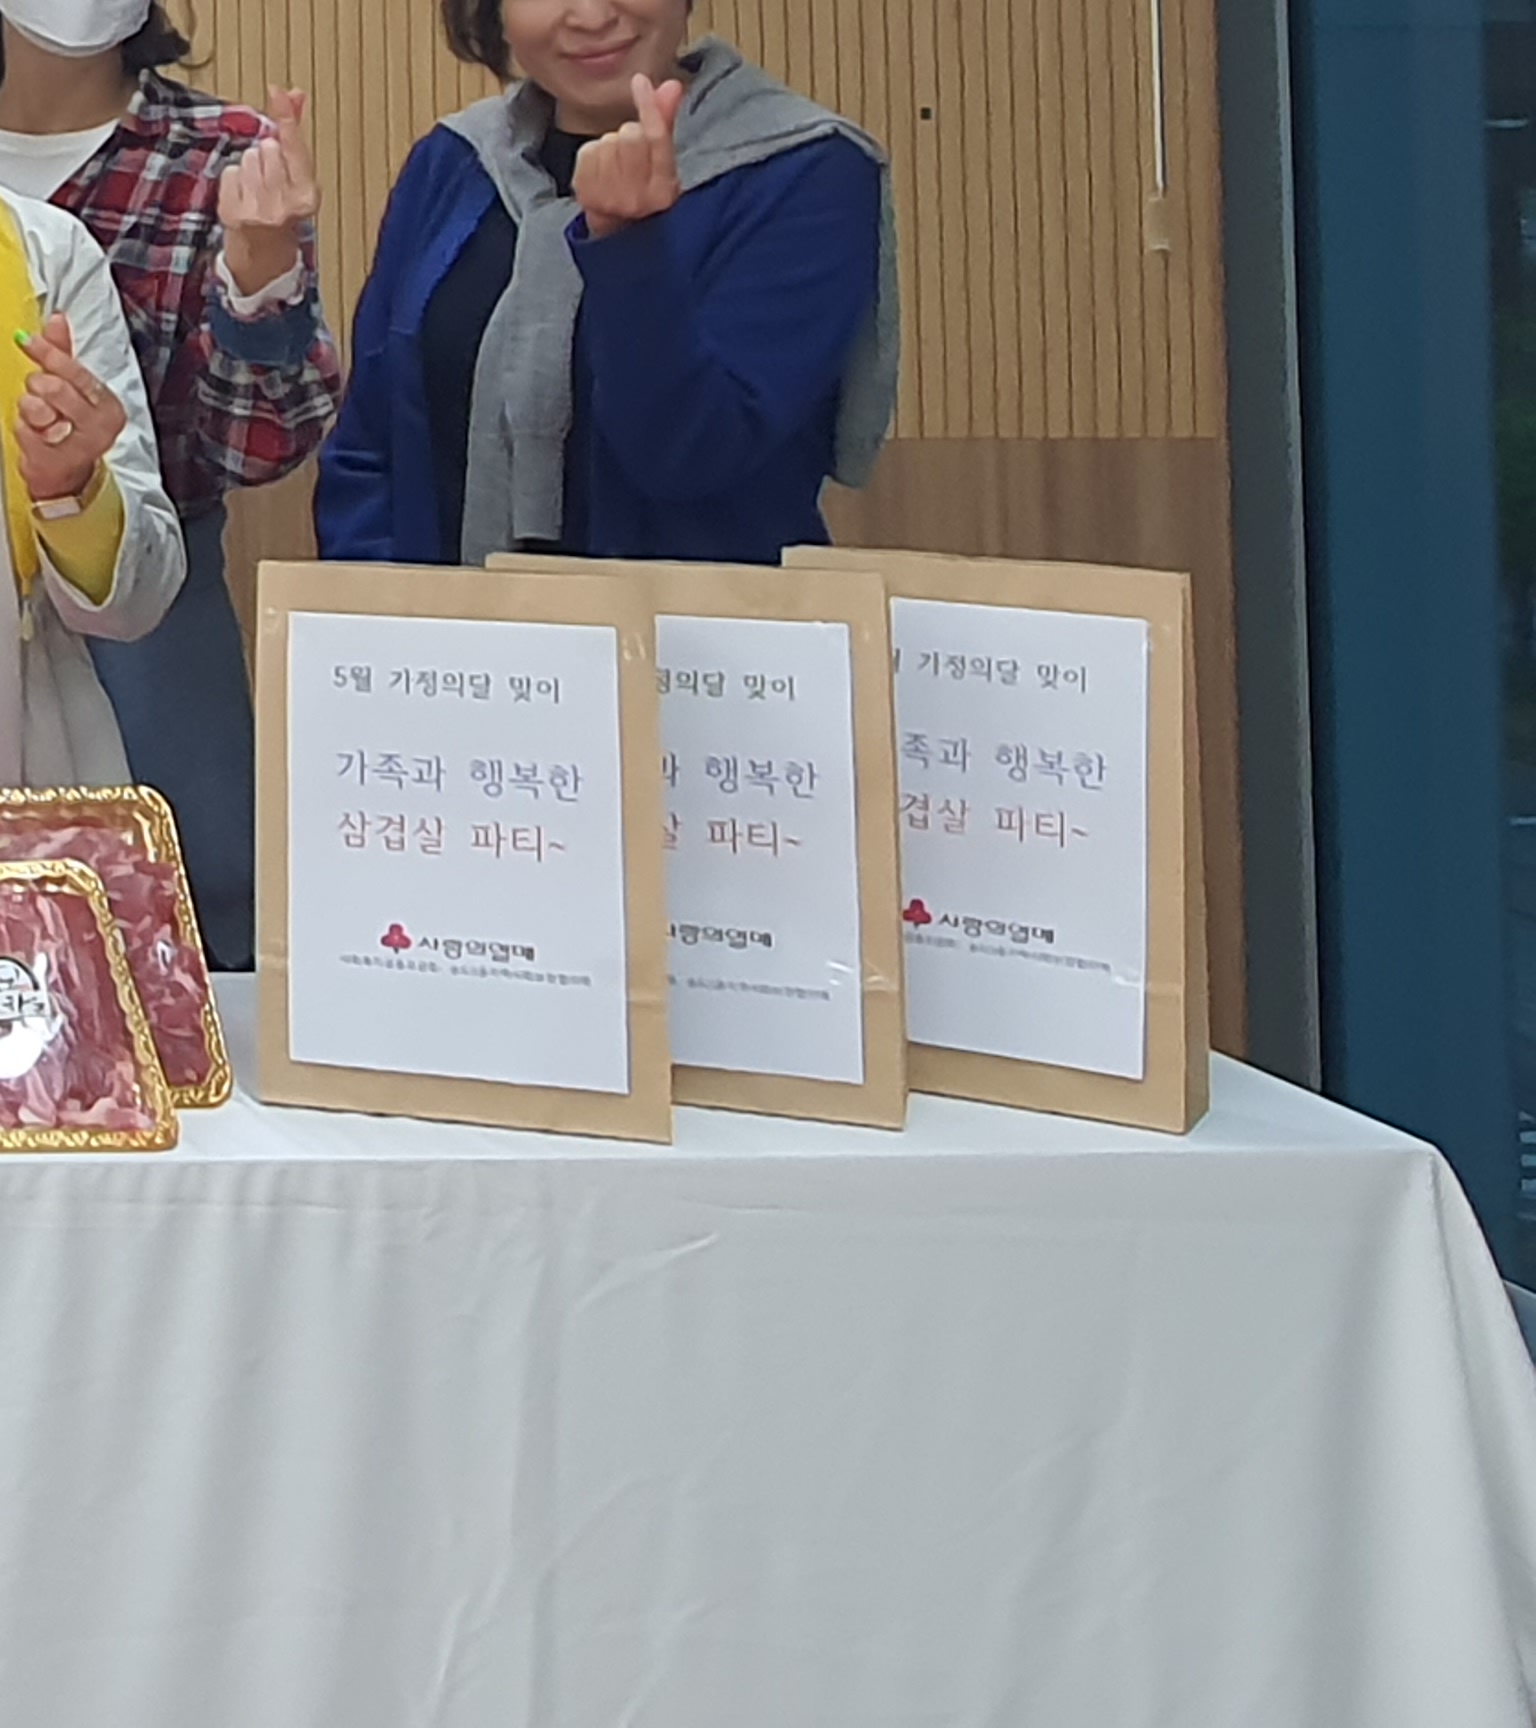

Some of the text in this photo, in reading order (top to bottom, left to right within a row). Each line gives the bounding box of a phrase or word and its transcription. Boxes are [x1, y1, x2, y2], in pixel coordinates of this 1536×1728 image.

[333, 665, 559, 704] 5월 가정의달 맞이
[918, 651, 1020, 686] 가정의달
[1037, 664, 1086, 694] 맞이
[337, 749, 584, 802] 가족과 행복한
[704, 755, 820, 799] 행복한
[995, 743, 1107, 792] 행복한
[336, 810, 565, 864] 삼겹살 파티~
[707, 818, 801, 857] 파티~
